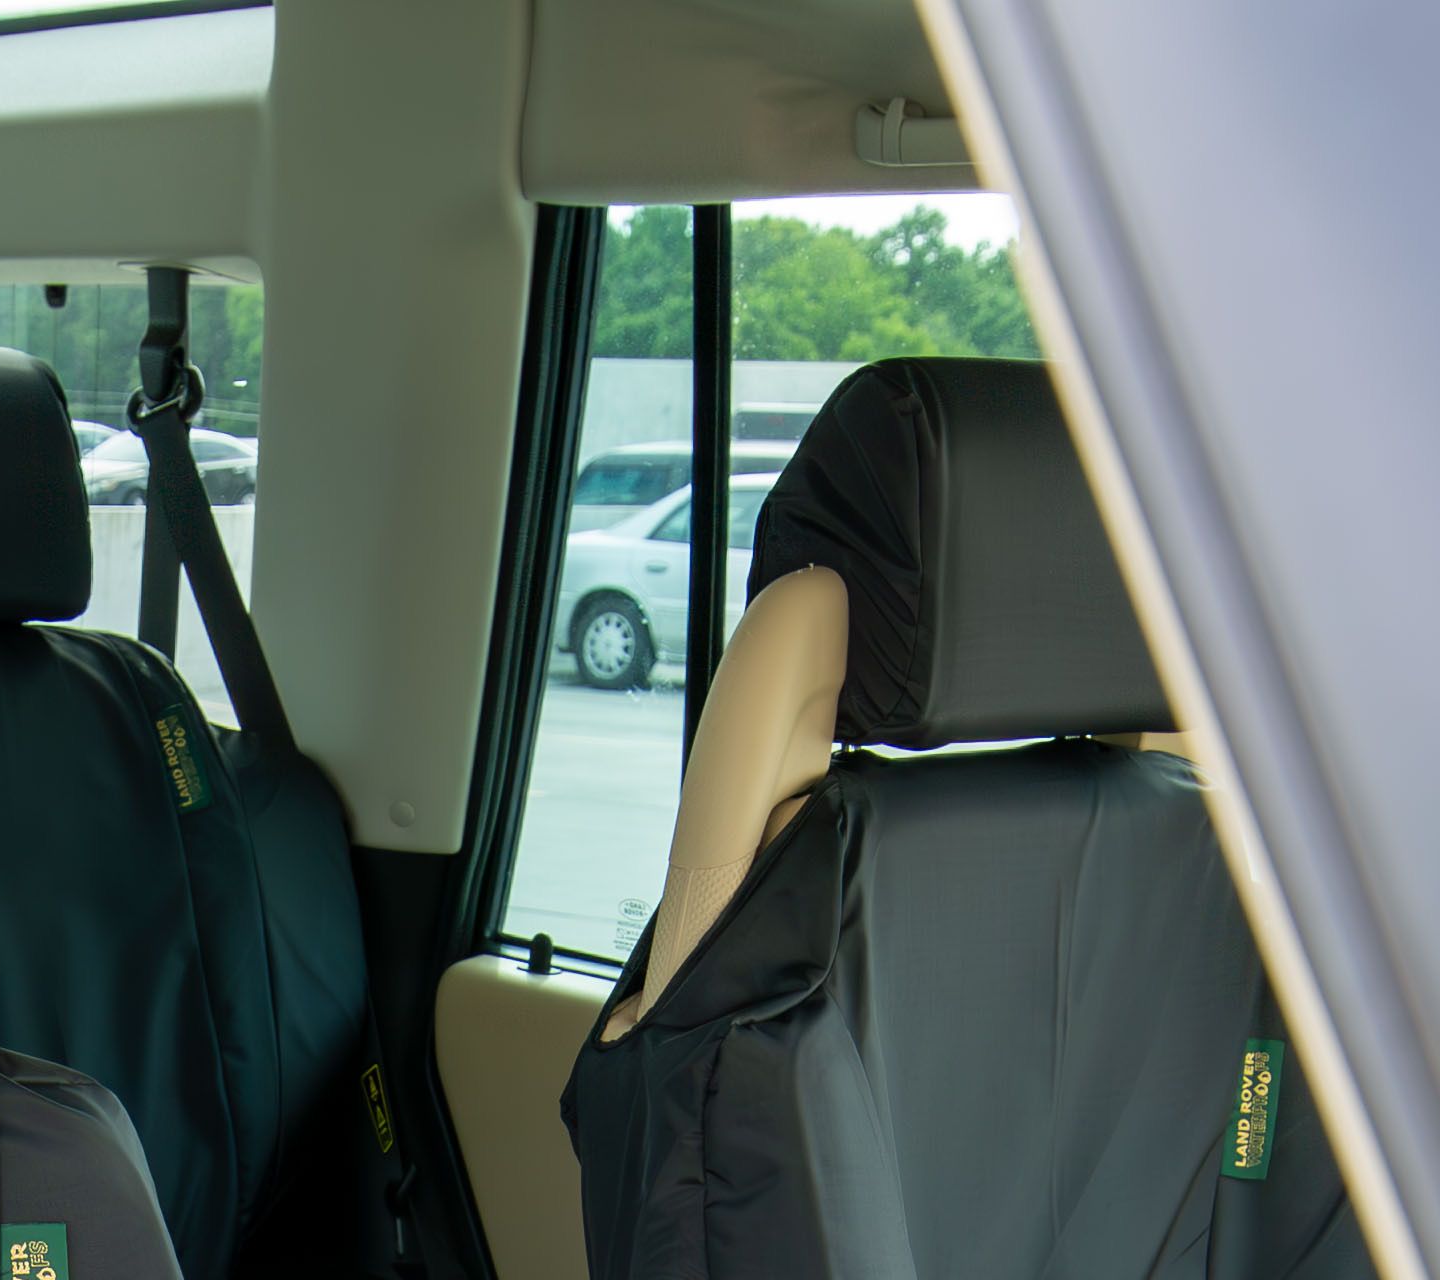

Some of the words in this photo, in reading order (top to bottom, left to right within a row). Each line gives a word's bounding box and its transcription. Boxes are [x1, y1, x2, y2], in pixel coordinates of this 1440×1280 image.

[156, 720, 179, 767] ROVER
[173, 768, 193, 807] LAND
[1240, 1052, 1256, 1114] ROVER
[1235, 1118, 1251, 1168] LAND
